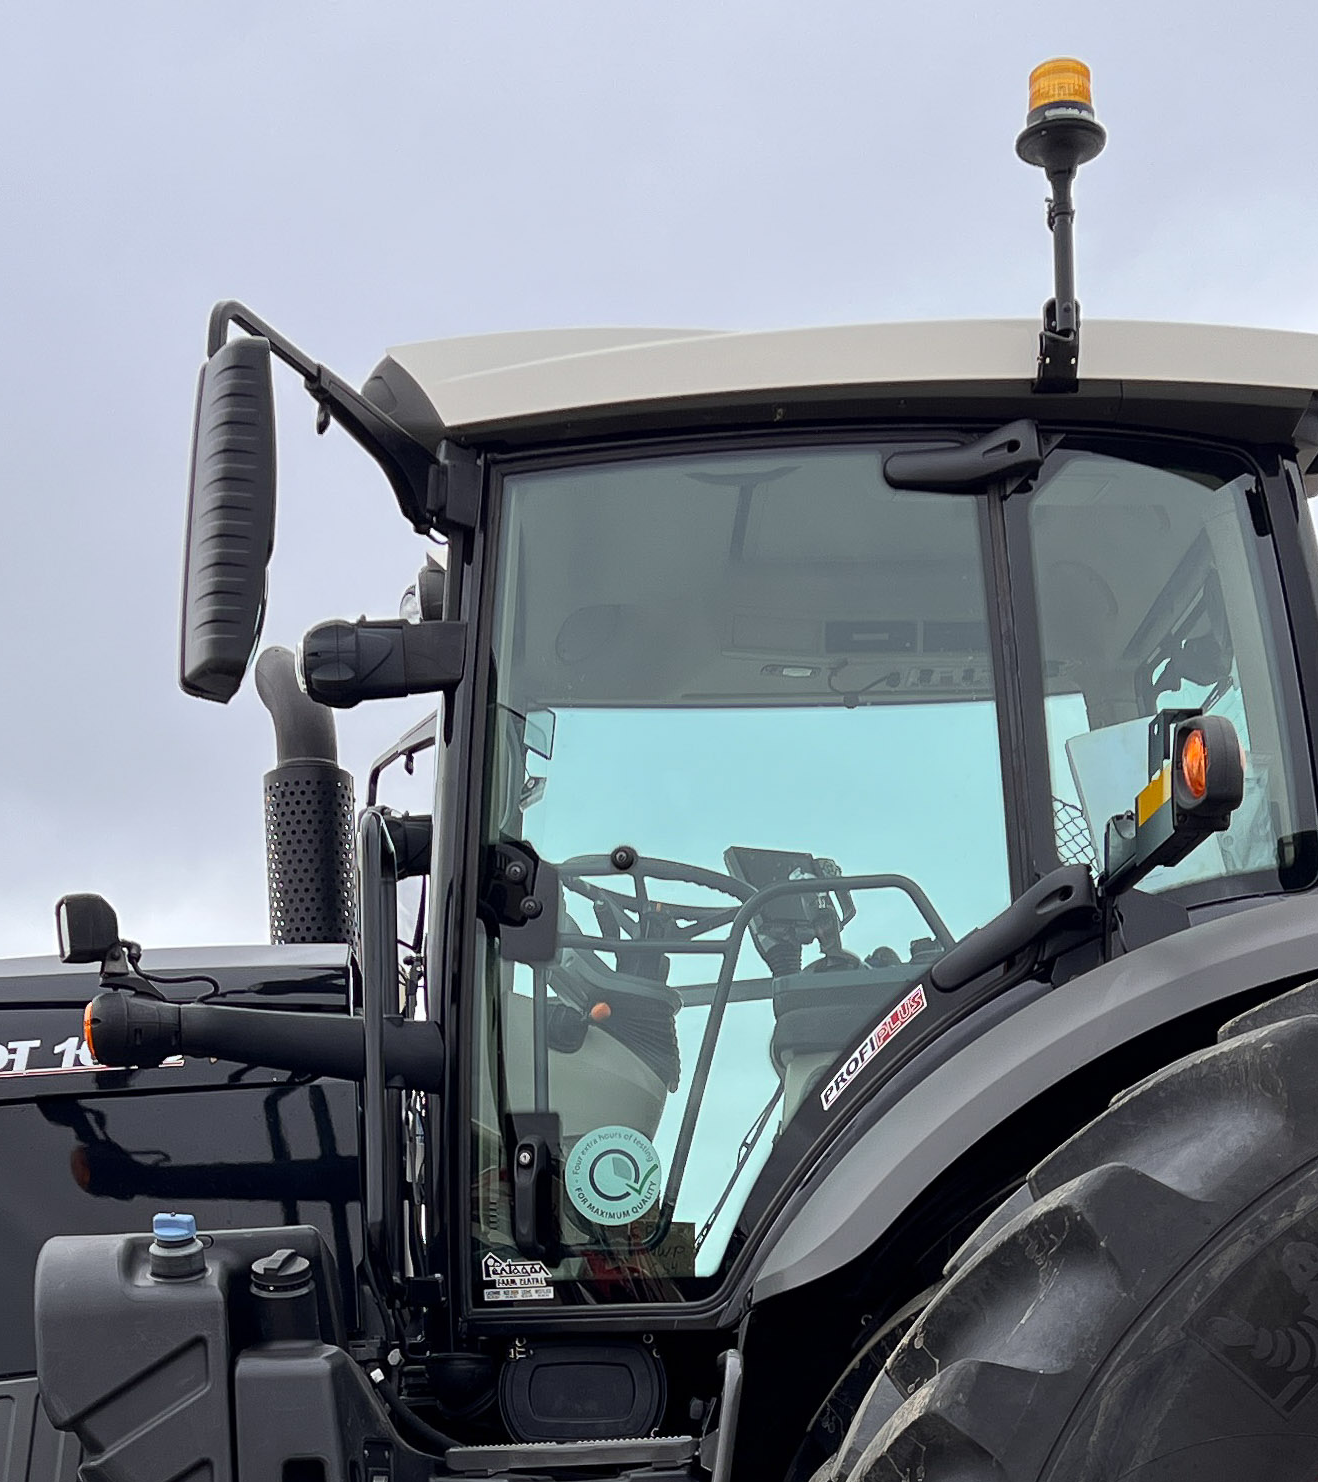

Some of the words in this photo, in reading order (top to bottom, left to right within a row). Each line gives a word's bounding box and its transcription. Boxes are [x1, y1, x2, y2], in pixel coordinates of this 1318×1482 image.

[572, 1156, 583, 1176] Four
[582, 1139, 598, 1156] extra
[598, 1132, 622, 1142] hours
[623, 1133, 633, 1142] of
[633, 1137, 655, 1163] testing
[574, 1187, 588, 1205] FOR
[587, 1202, 631, 1220] MAXIMUM
[631, 1180, 658, 1215] QUALITY
